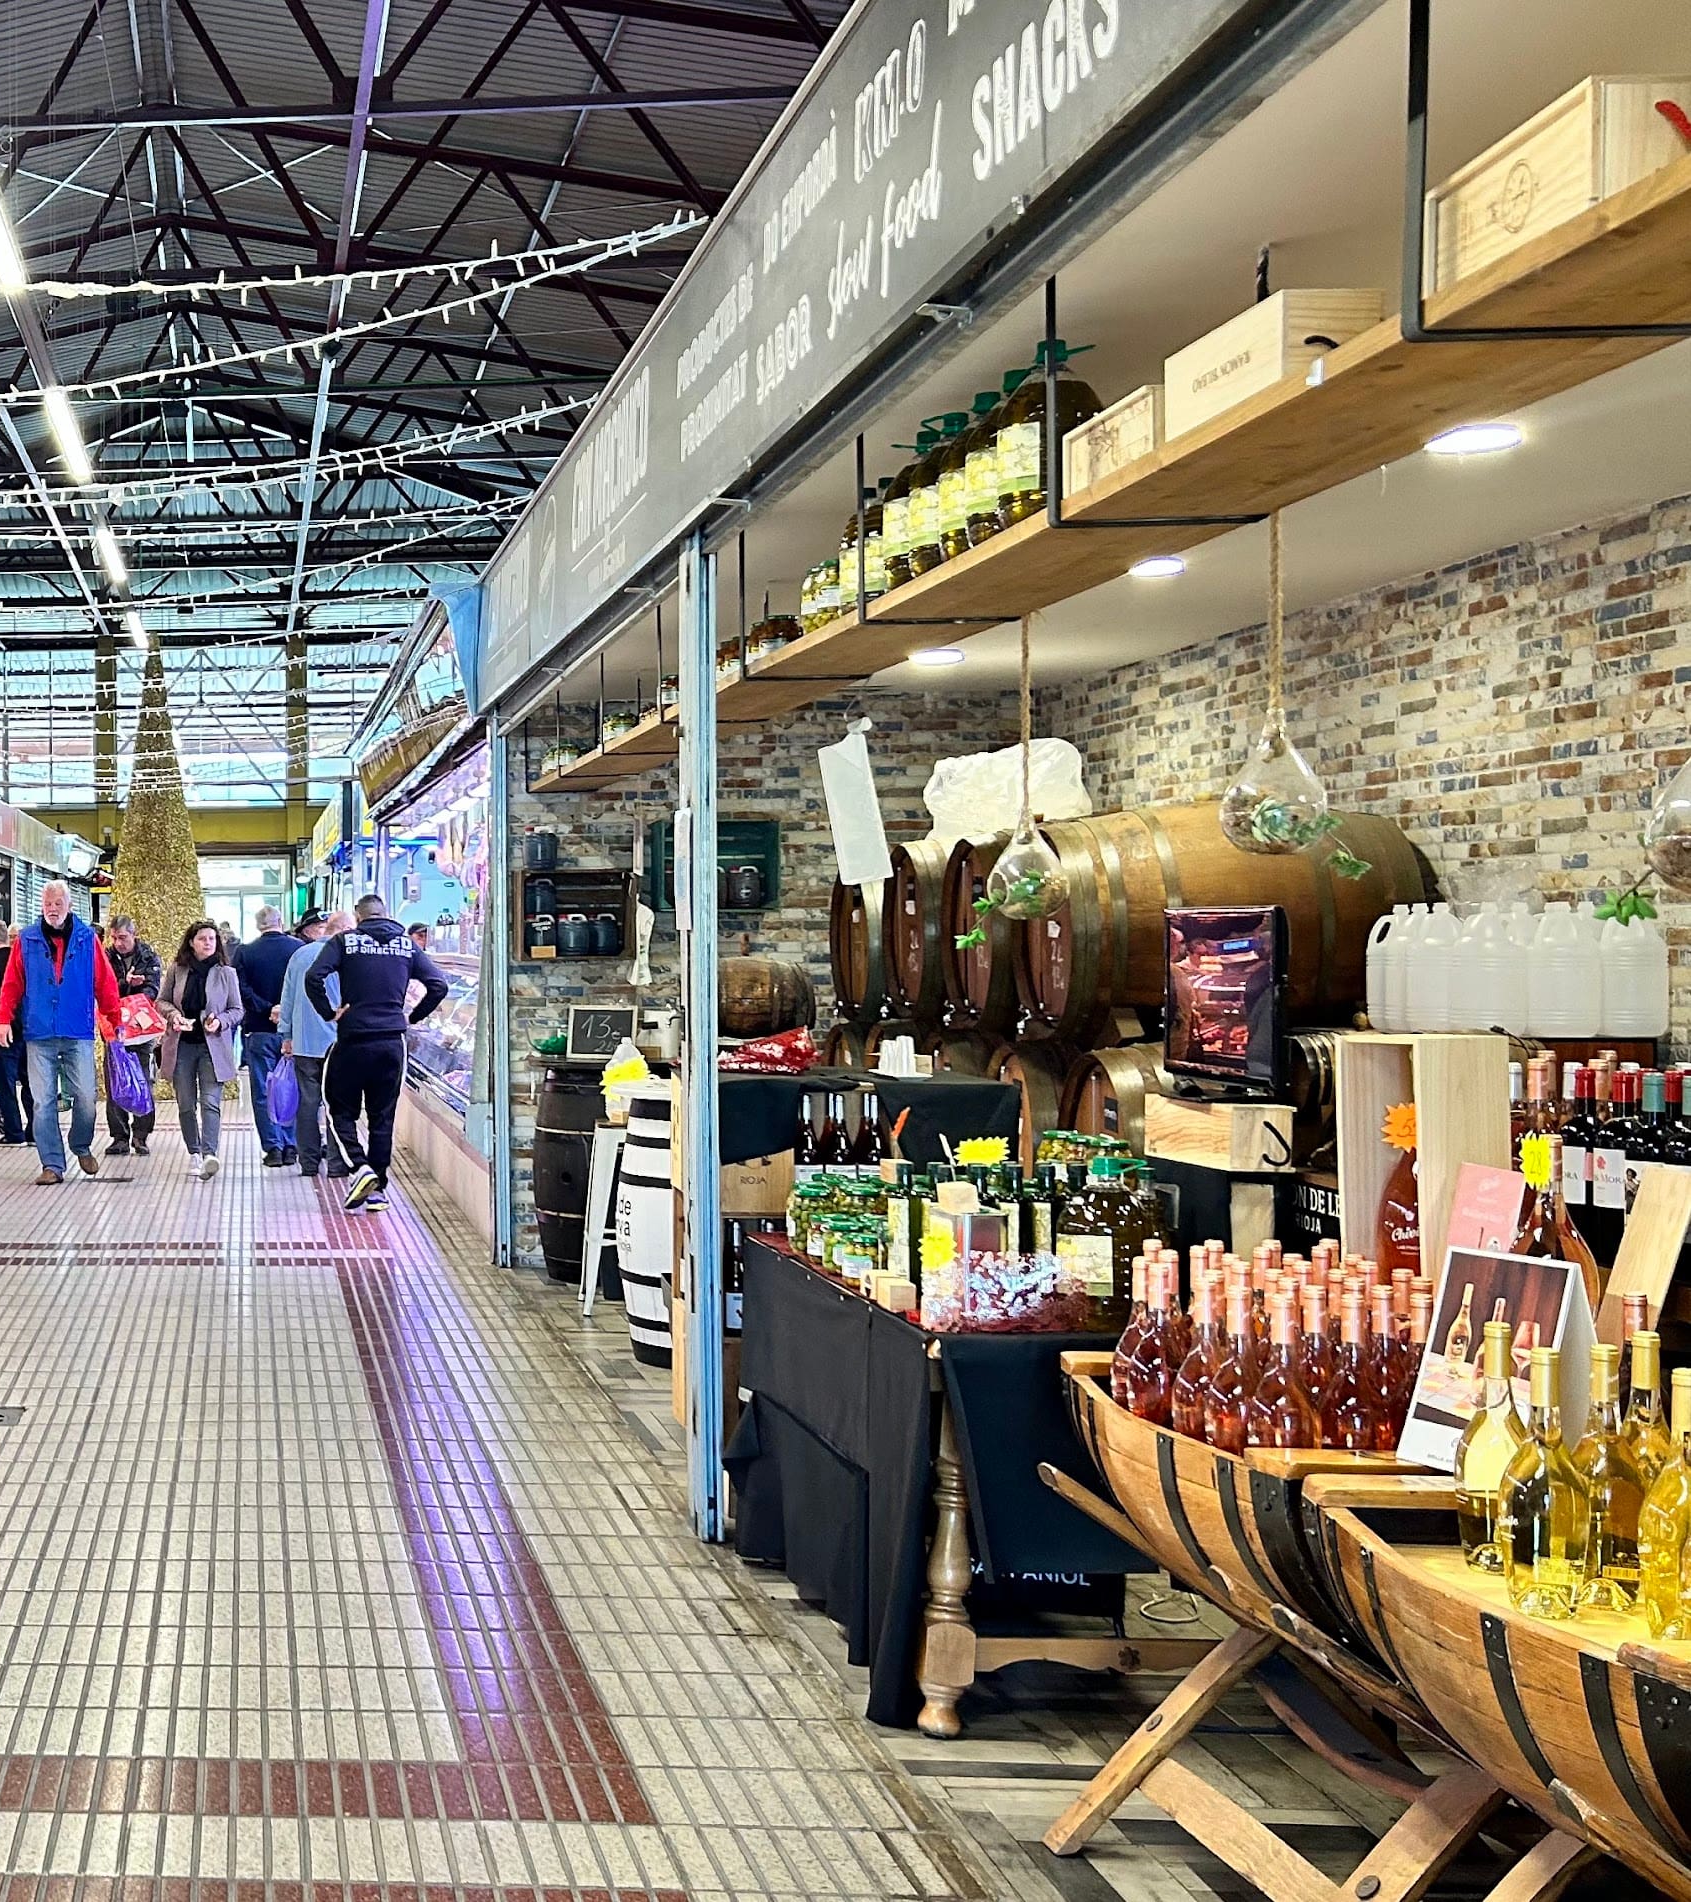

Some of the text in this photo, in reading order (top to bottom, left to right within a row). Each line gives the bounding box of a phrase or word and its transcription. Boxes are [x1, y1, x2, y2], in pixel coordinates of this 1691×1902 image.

[756, 293, 812, 406] SABOR
[880, 99, 942, 298] food
[345, 947, 413, 958] OF DIRECTORS
[1309, 1187, 1327, 1214] DE
